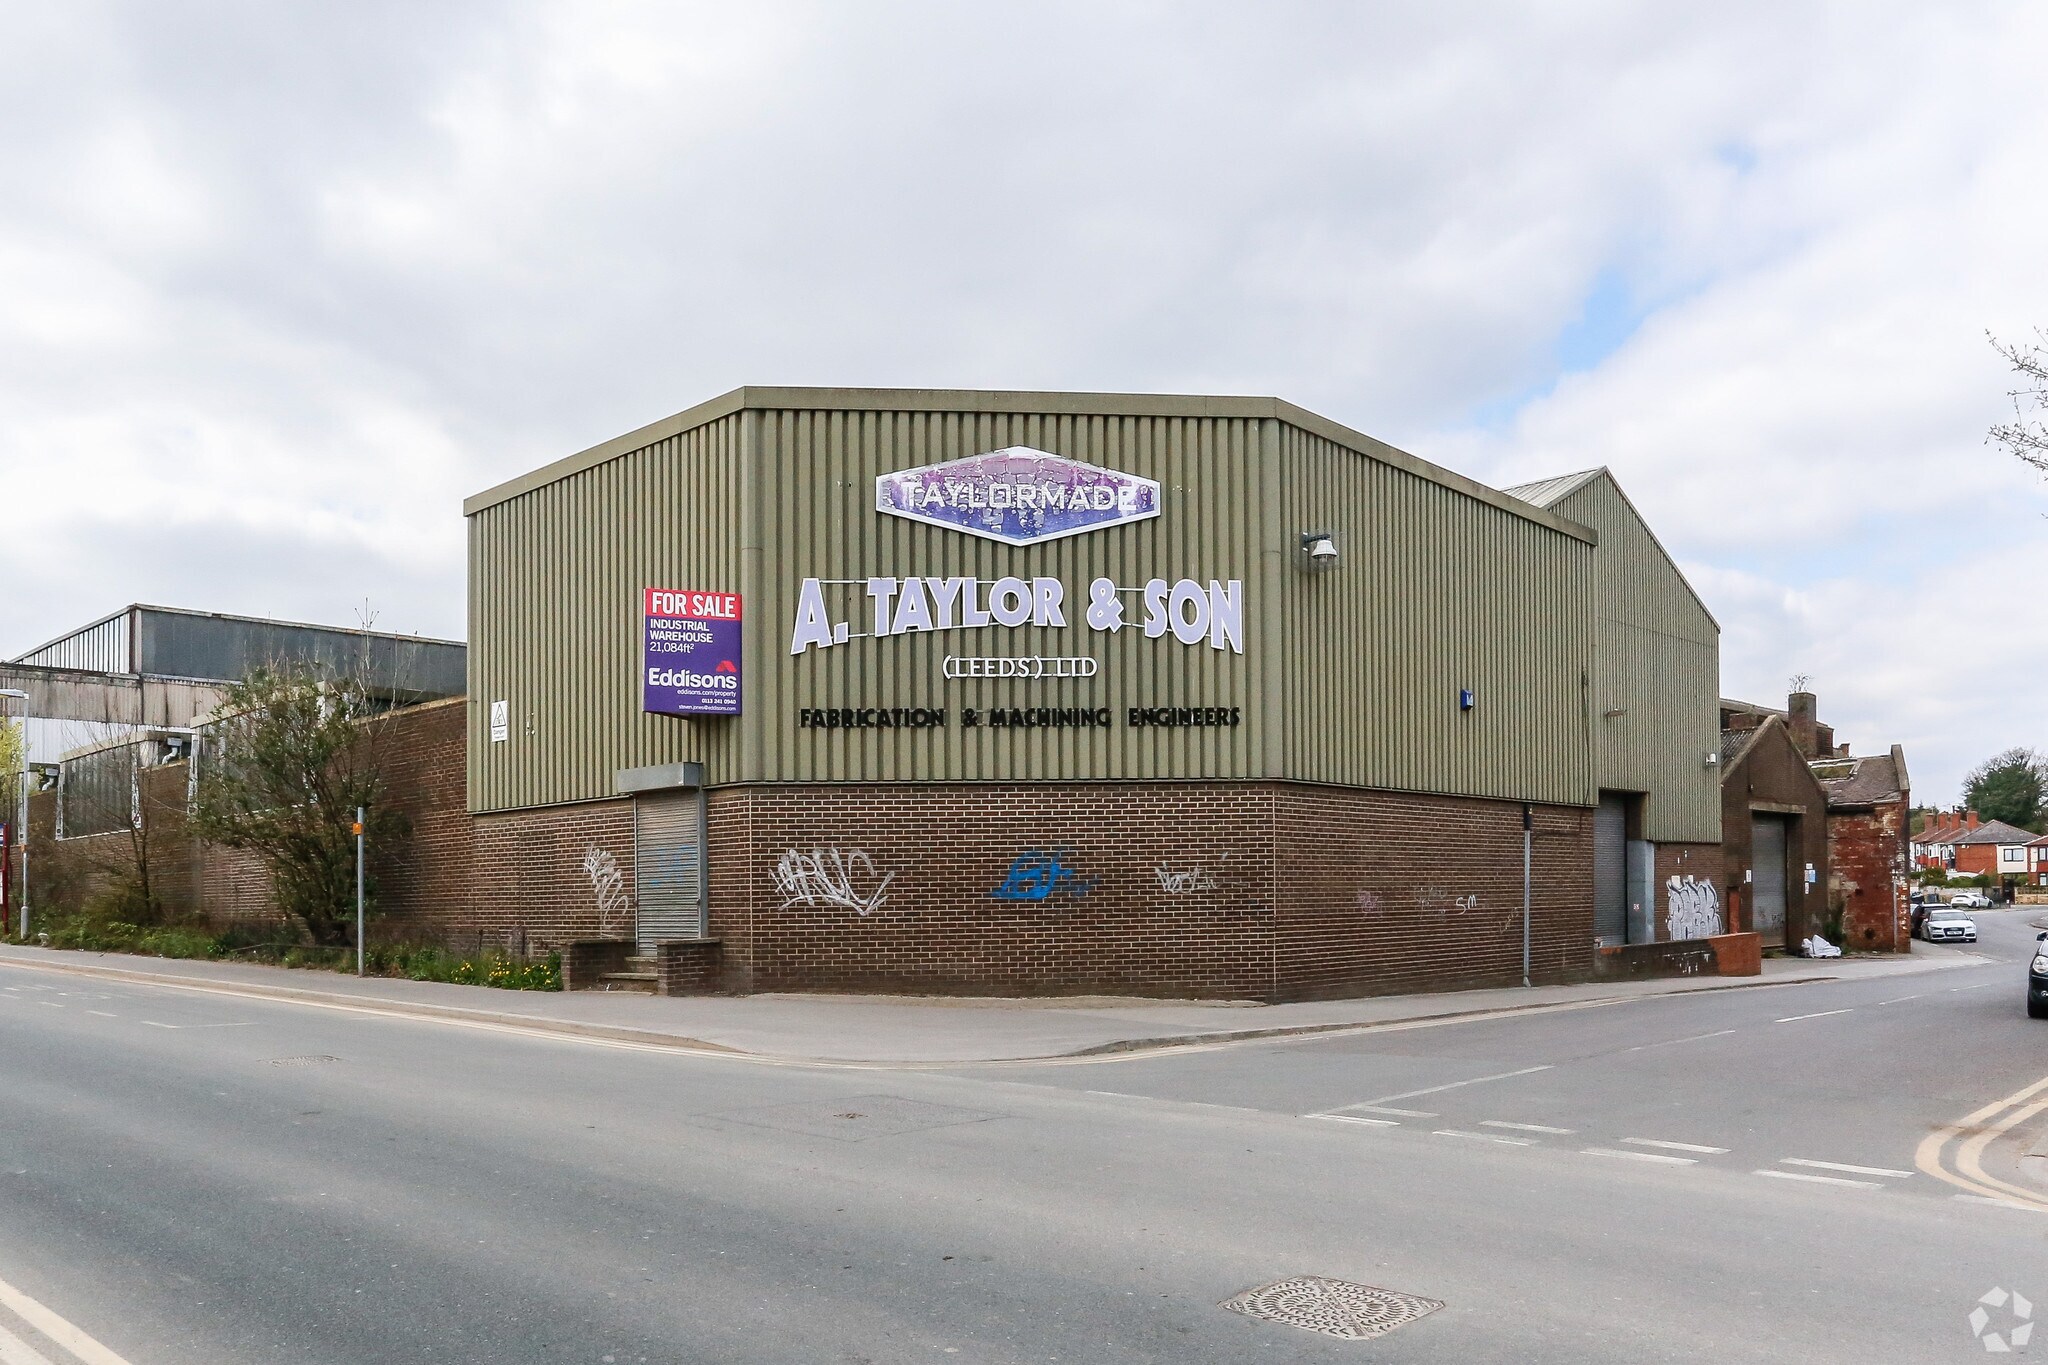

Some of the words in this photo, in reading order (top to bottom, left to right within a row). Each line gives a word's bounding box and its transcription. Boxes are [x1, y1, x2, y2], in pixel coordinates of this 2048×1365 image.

[900, 481, 1138, 511] TAYLORMADE
[652, 592, 687, 615] FOR
[692, 595, 736, 618] SALE
[650, 618, 710, 632] INDUSTRIAL
[790, 577, 849, 655] A.
[867, 577, 1068, 638] TAYLOR
[1086, 577, 1124, 634] &
[1143, 578, 1243, 655] SON
[649, 630, 714, 643] WAREHOUSE
[942, 654, 1043, 680] (LEEDS)
[1056, 656, 1098, 677] LTD
[648, 668, 737, 689] Eddisons
[677, 689, 736, 697] eddisons.com/property
[800, 707, 945, 728] FABRICATION
[963, 708, 978, 728] &
[988, 707, 1112, 728] MACHINING
[1128, 707, 1240, 727] ENGINEERS
